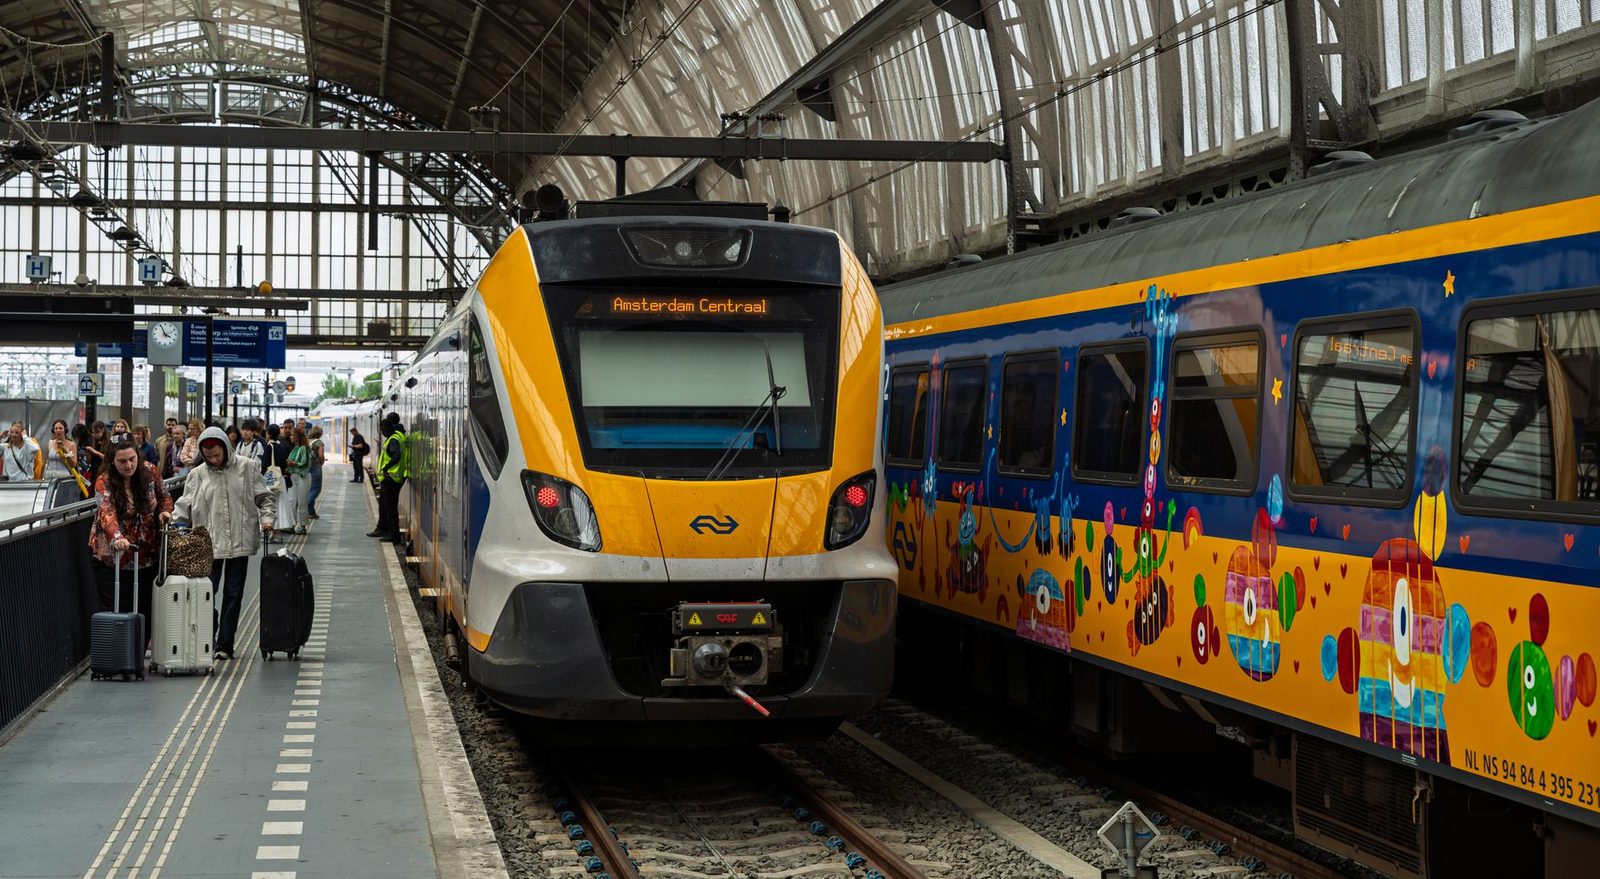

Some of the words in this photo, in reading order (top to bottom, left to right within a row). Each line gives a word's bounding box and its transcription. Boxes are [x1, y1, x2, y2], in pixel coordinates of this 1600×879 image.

[32, 261, 43, 275] H
[144, 264, 155, 279] H
[613, 297, 695, 312] Amsterdam
[699, 298, 767, 313] Centraal
[884, 364, 889, 400] 2
[1465, 749, 1479, 771] NL
[1483, 754, 1498, 776] NS
[1502, 759, 1516, 782] 94
[1520, 764, 1535, 787] 84
[1538, 771, 1546, 791] 4
[1551, 773, 1574, 799] 395
[1578, 782, 1600, 808] 231
